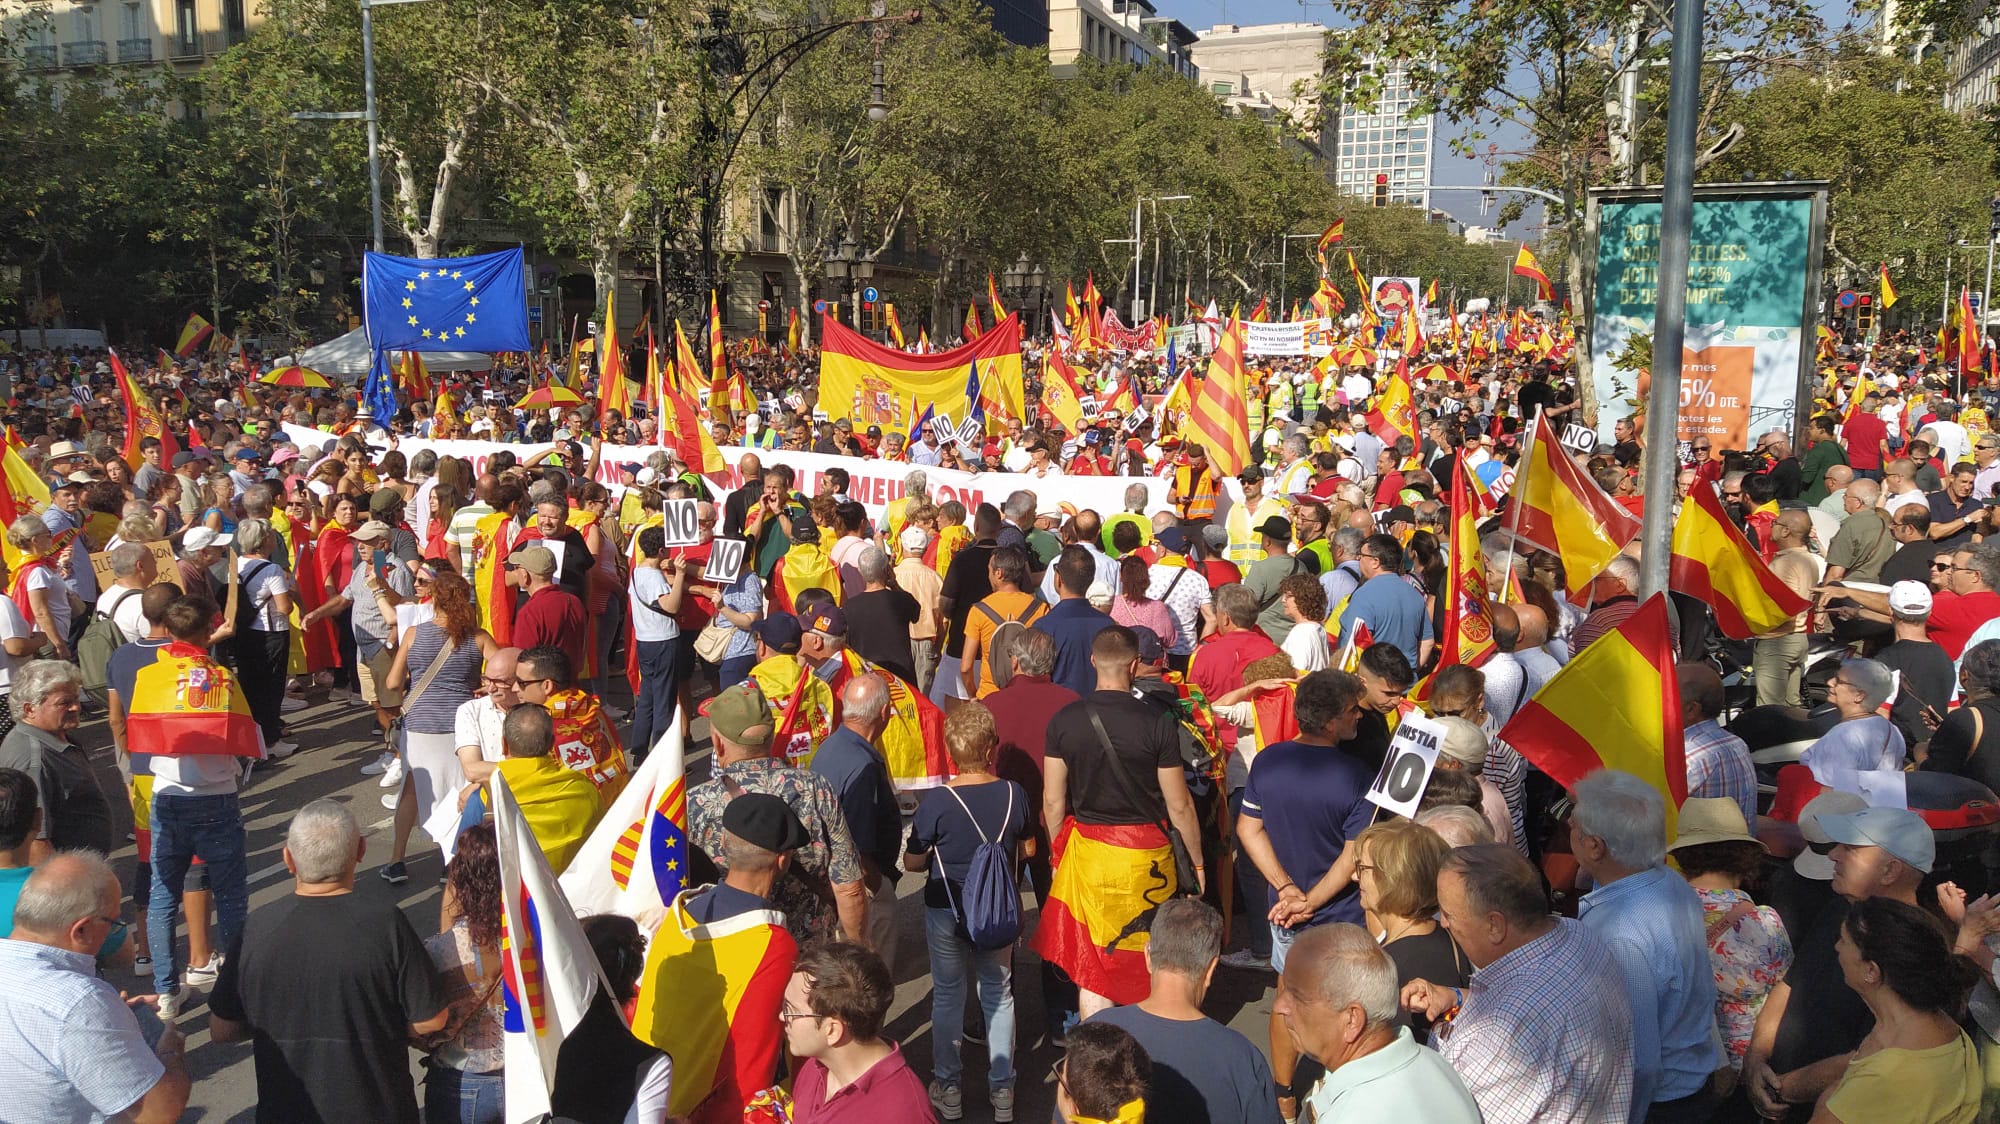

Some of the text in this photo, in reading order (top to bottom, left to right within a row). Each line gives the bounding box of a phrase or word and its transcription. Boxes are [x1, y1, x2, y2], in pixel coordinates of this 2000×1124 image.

[1698, 266, 1731, 283] 25%
[1620, 288, 1638, 304] DE
[1691, 363, 1717, 372] mes
[72, 386, 91, 402] NO
[1719, 396, 1740, 408] DTE.
[633, 407, 647, 419] NO
[1082, 403, 1096, 418] NO
[1707, 414, 1723, 423] les
[932, 415, 953, 440] NO
[1124, 412, 1141, 430] NO
[1686, 425, 1727, 434] estades
[955, 418, 978, 442] NO
[1563, 425, 1594, 449] NO
[848, 474, 906, 505] MEU
[1490, 471, 1516, 497] NO
[664, 500, 698, 541] NO
[706, 540, 743, 578] NO
[1372, 745, 1426, 803] NO
